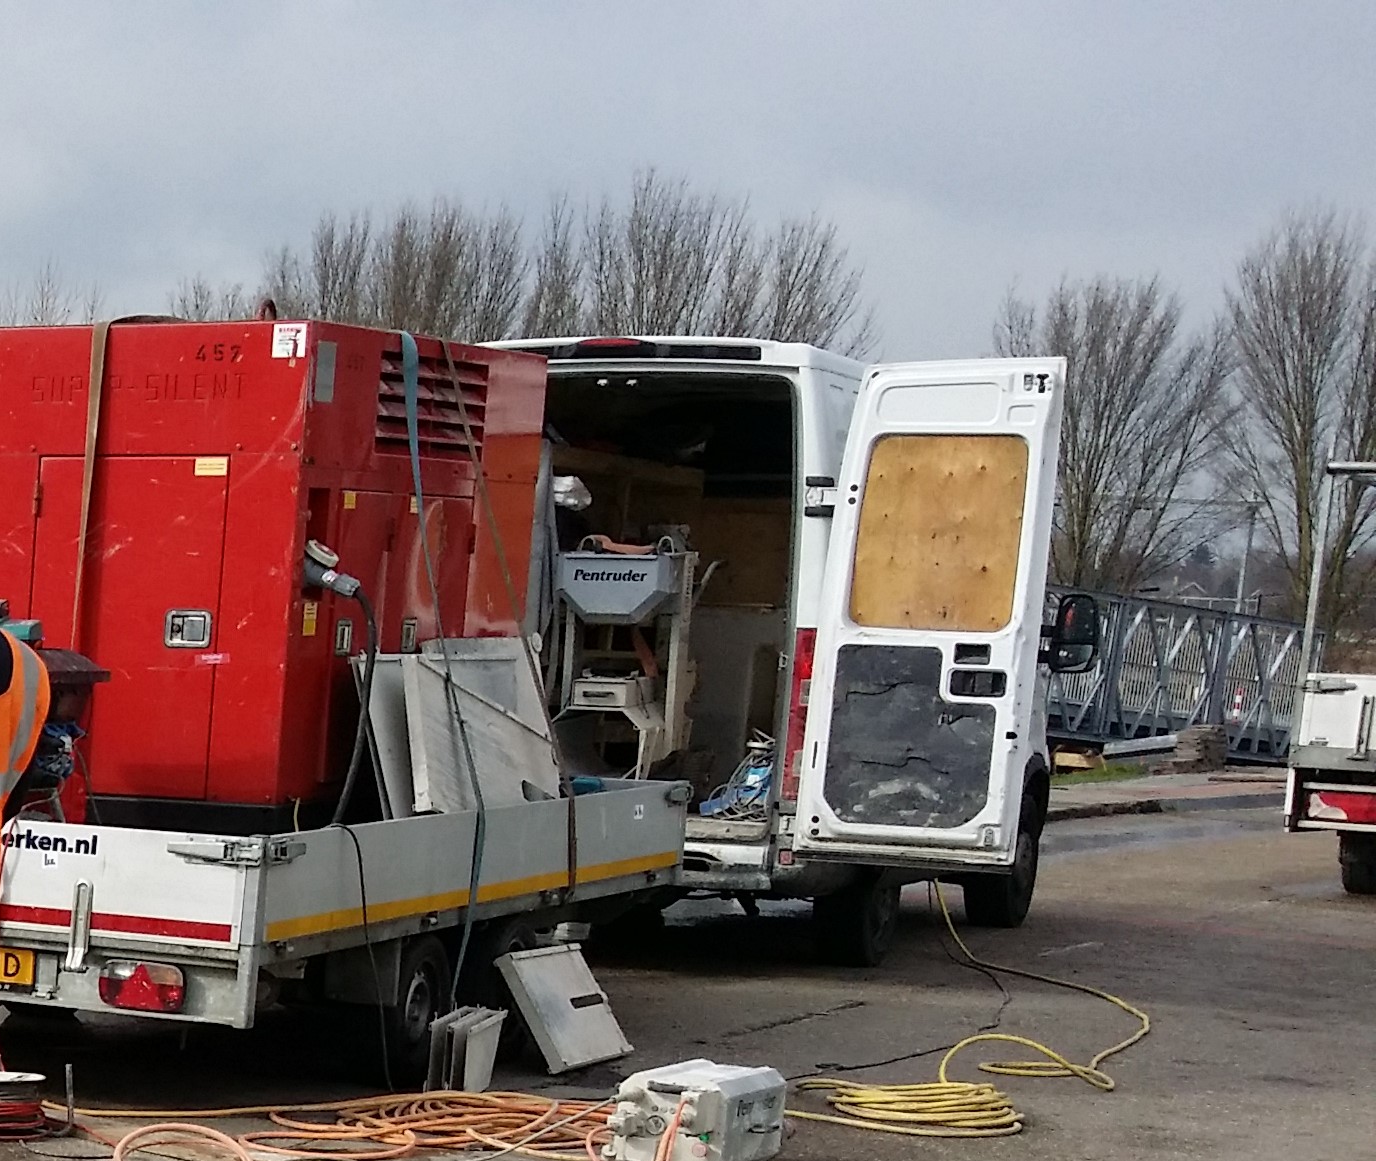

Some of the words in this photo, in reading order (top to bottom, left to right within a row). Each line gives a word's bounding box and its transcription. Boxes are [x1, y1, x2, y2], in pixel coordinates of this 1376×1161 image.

[32, 372, 246, 402] SUPR-SILENT
[574, 569, 647, 581] Pentruder
[2, 829, 98, 855] erken.nl
